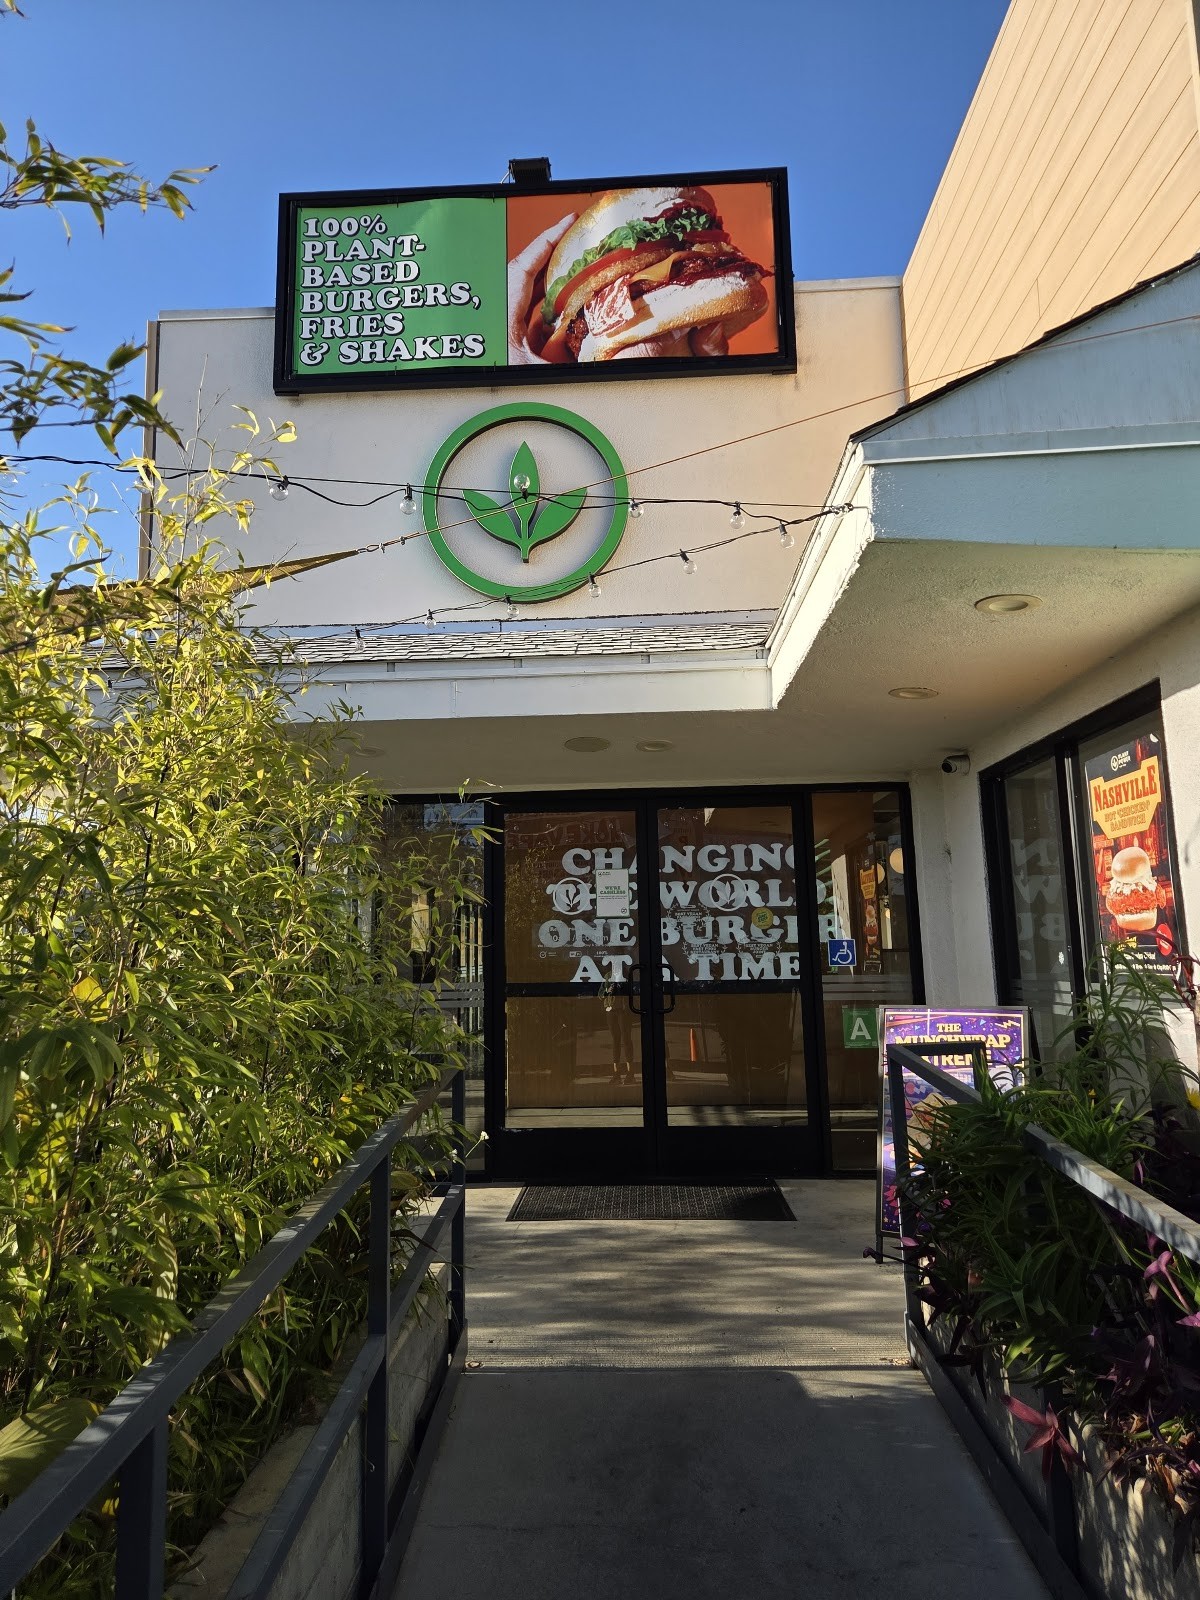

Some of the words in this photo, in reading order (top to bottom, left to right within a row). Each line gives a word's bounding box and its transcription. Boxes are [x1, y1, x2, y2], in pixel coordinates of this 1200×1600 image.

[303, 214, 387, 237] 100%
[302, 234, 426, 262] PLANT-
[301, 260, 420, 287] BASED
[301, 282, 481, 314] BURGERS,
[300, 312, 405, 339] FRIES
[300, 342, 329, 365] &
[338, 334, 485, 364] SHAKES
[1093, 765, 1157, 812] NASHVILLE
[538, 918, 637, 948] ONE
[570, 954, 632, 982] AT
[689, 951, 800, 981] TIME
[850, 1017, 872, 1040] A
[936, 1023, 962, 1033] THE
